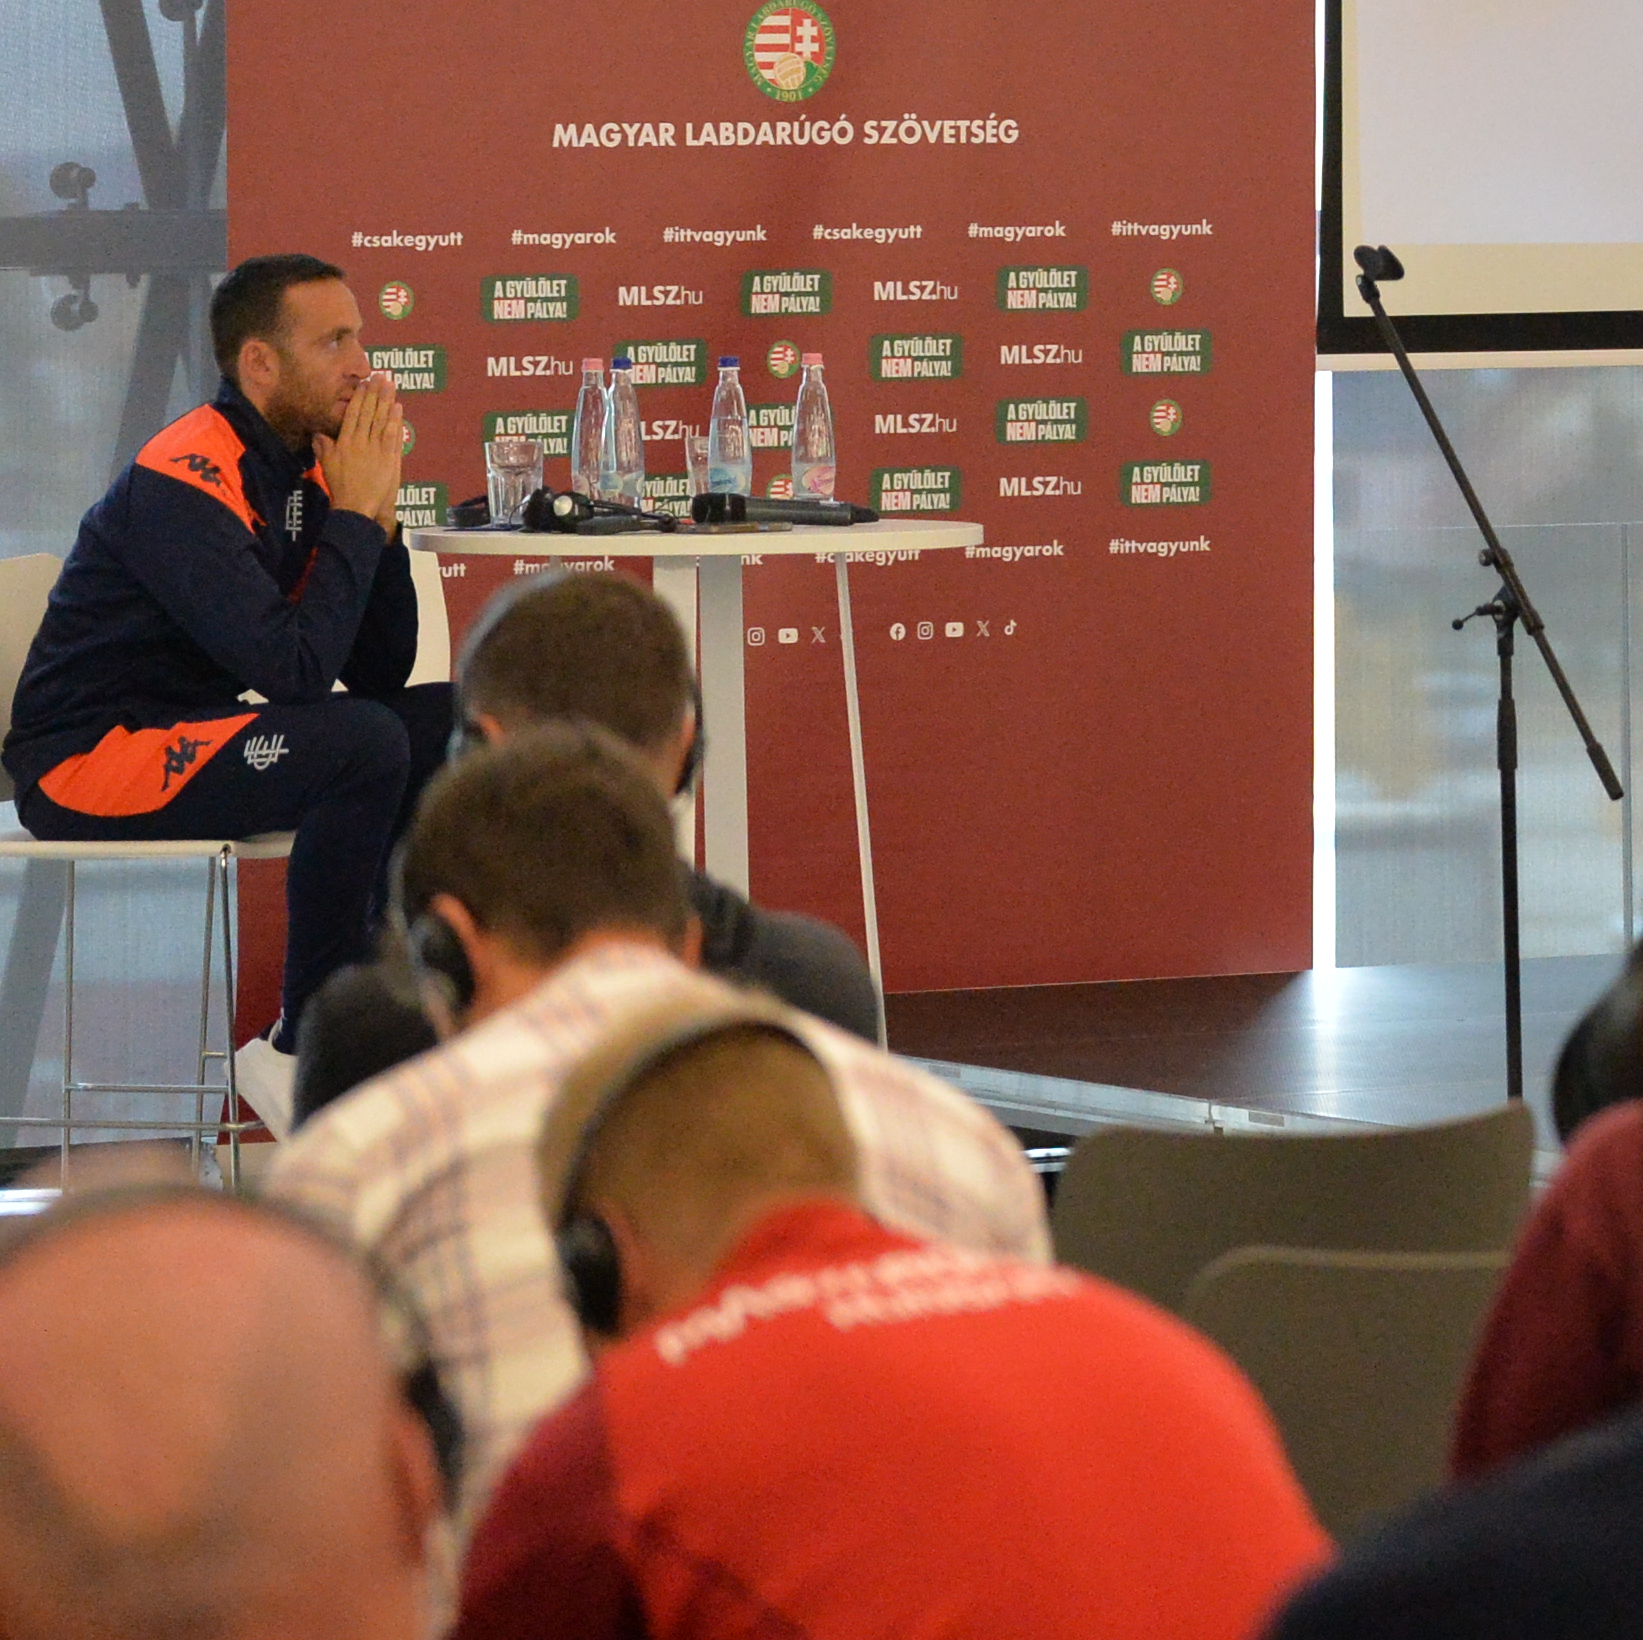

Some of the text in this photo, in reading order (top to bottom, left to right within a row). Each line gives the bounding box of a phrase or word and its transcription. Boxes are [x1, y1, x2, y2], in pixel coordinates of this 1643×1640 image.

[775, 91, 803, 102] 1901
[552, 112, 1020, 148] MAGYAR LABDARÚGÓ SZÖVETSÉG
[511, 226, 616, 249] #magyarok
[663, 224, 767, 247] #ittvagyunk
[813, 223, 922, 244] #csakegyutt
[967, 220, 1066, 241] #magyarok
[1111, 219, 1213, 241] #ittvagyunk
[351, 231, 463, 251] #csakegyutt
[494, 282, 505, 298] A
[753, 276, 761, 293] A
[873, 280, 958, 301] MLSZ.hu
[1008, 271, 1018, 289] A
[618, 284, 704, 307] MLSZ.hu
[751, 292, 820, 313] NEM PÁLYA!
[1006, 288, 1077, 309] NEM PÁLYA!
[492, 299, 567, 319] NEM PÁLYA!
[882, 340, 892, 357] A
[1132, 334, 1144, 352] A
[999, 343, 1083, 365] MLSZ.hu
[1132, 352, 1201, 373] NEM PÁLYA!
[486, 355, 574, 377] MLSZ.hu
[656, 364, 696, 384] PÁLYA!
[880, 357, 952, 378] NEM PÁLYA!
[1007, 403, 1018, 420] A
[495, 416, 506, 434] A
[874, 413, 957, 435] MLSZ.hu
[1006, 420, 1076, 441] NEM PÁLYA!
[750, 428, 779, 447] NEM
[882, 473, 892, 490] A
[1132, 467, 1142, 484] A
[999, 476, 1082, 497] MLSZ.hu
[1131, 483, 1200, 504] NEM PÁLYA!
[880, 491, 951, 511] NEM PÁLYA!
[965, 539, 1065, 563] #magyarok
[1108, 535, 1211, 557] #ittvagyunk
